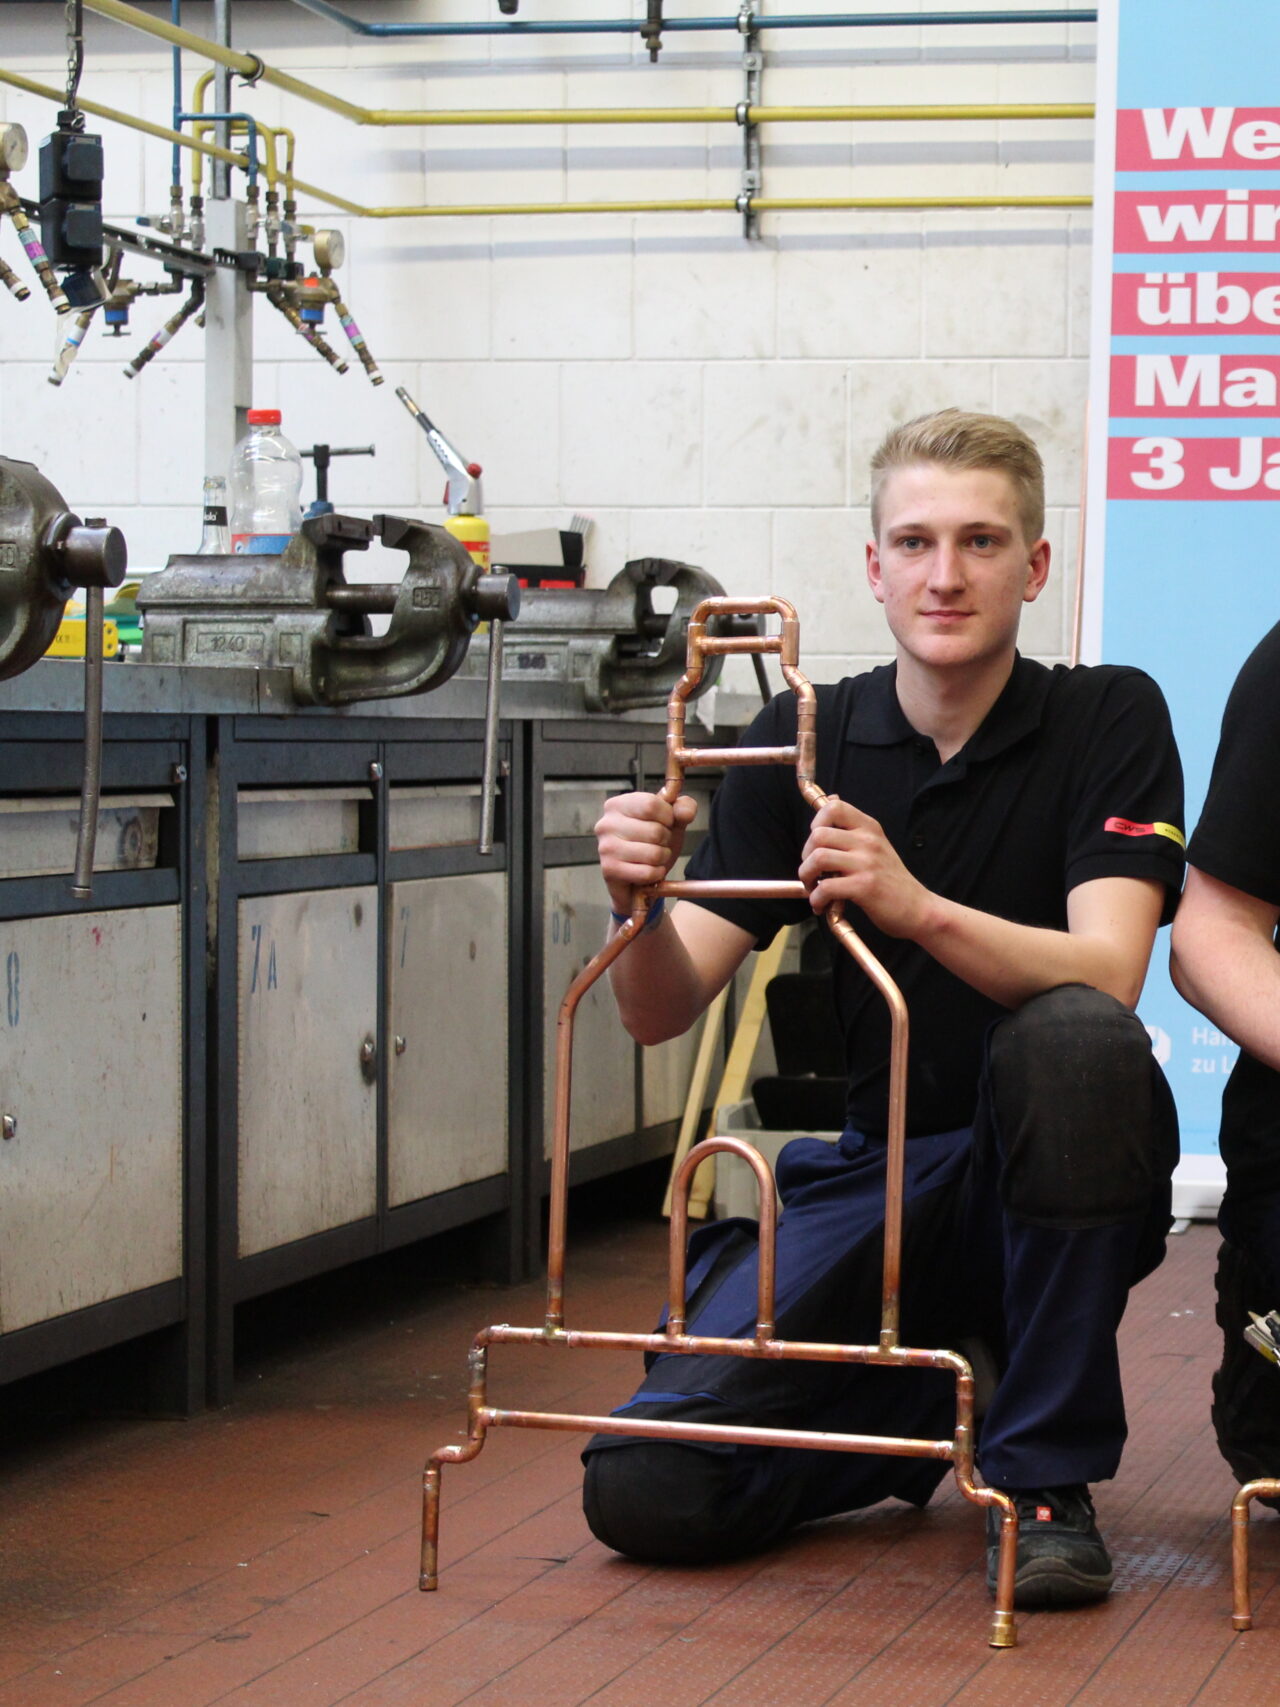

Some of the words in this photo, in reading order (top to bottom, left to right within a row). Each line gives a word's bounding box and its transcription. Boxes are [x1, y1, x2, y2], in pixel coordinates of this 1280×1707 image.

[1130, 436, 1185, 491] 3
[1113, 821, 1146, 834] CWS
[6, 950, 20, 1027] 8
[1191, 1057, 1216, 1073] zu
